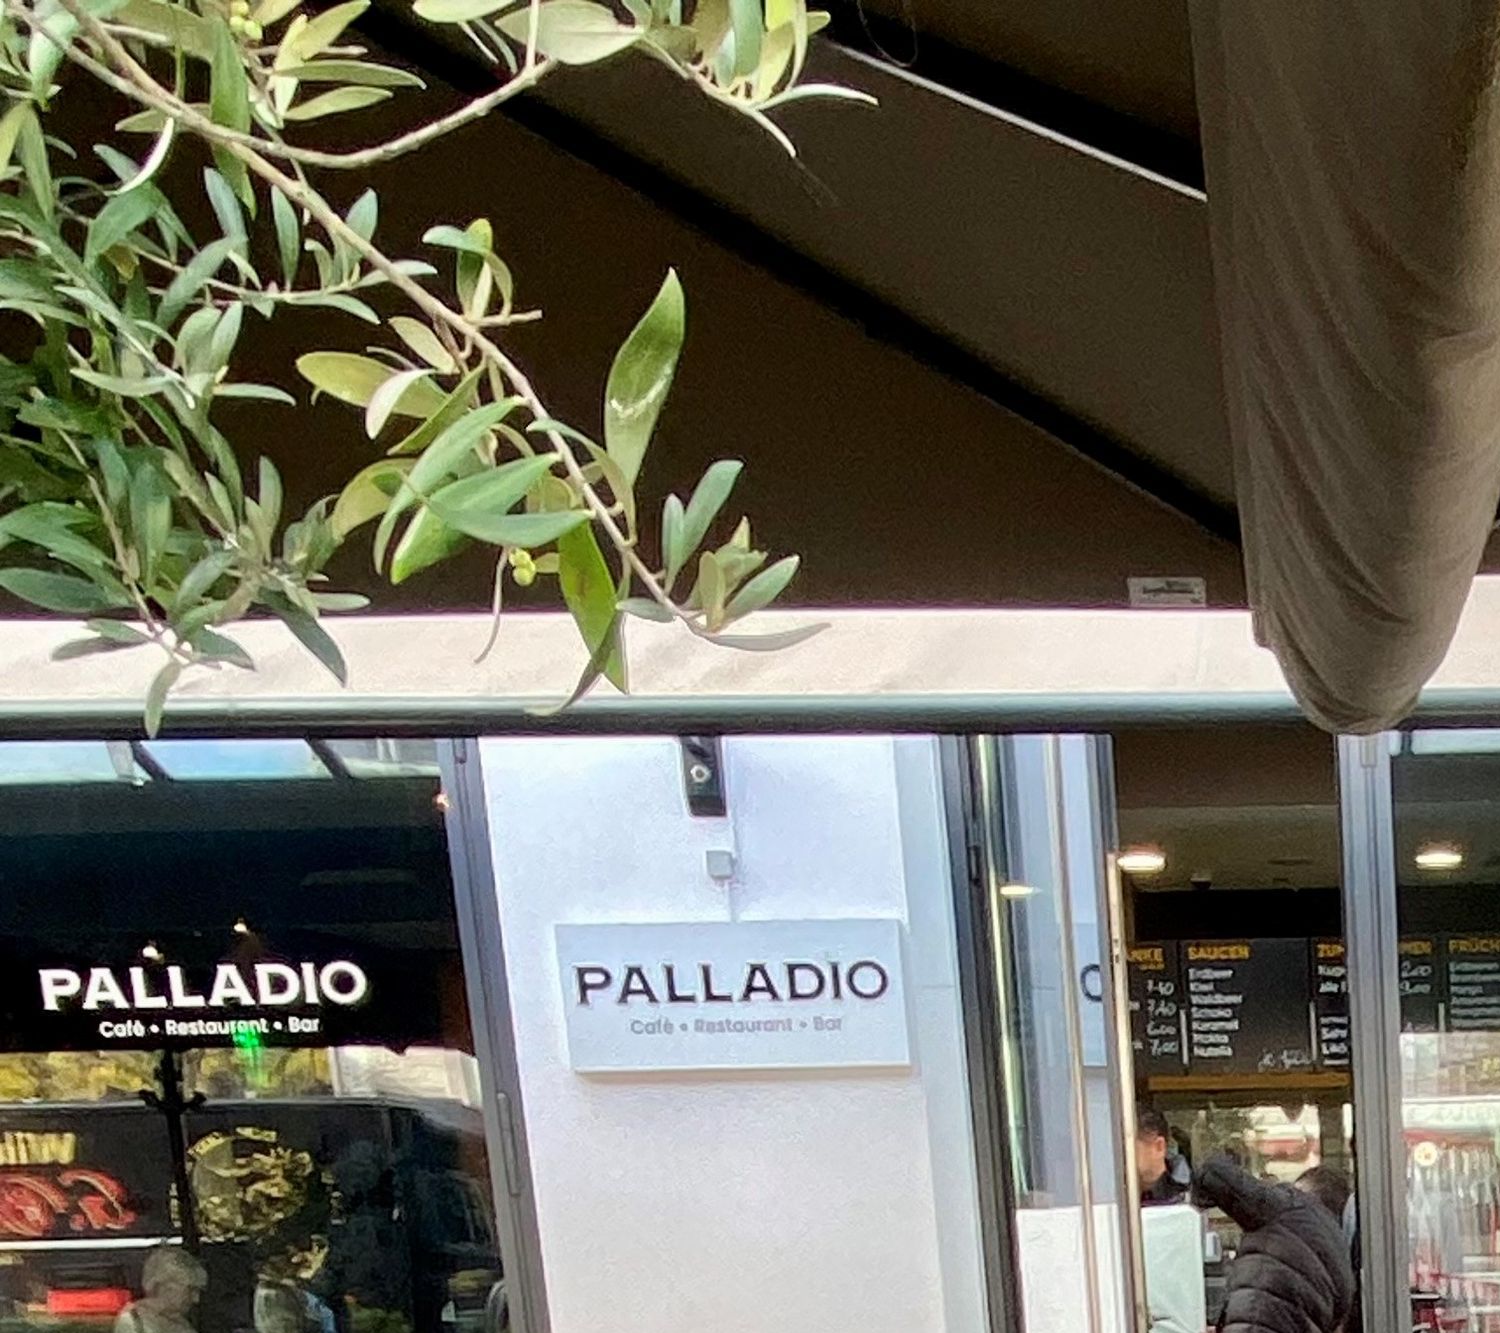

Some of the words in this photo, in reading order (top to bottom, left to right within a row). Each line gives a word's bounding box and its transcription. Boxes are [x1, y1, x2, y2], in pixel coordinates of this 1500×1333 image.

[38, 960, 368, 1010] PALLADIO
[575, 959, 890, 1005] PALLADIO
[165, 1018, 269, 1036] Restaurant
[288, 1016, 320, 1033] Bar
[694, 1017, 794, 1034] Restaurant
[813, 1016, 843, 1032] Bar
